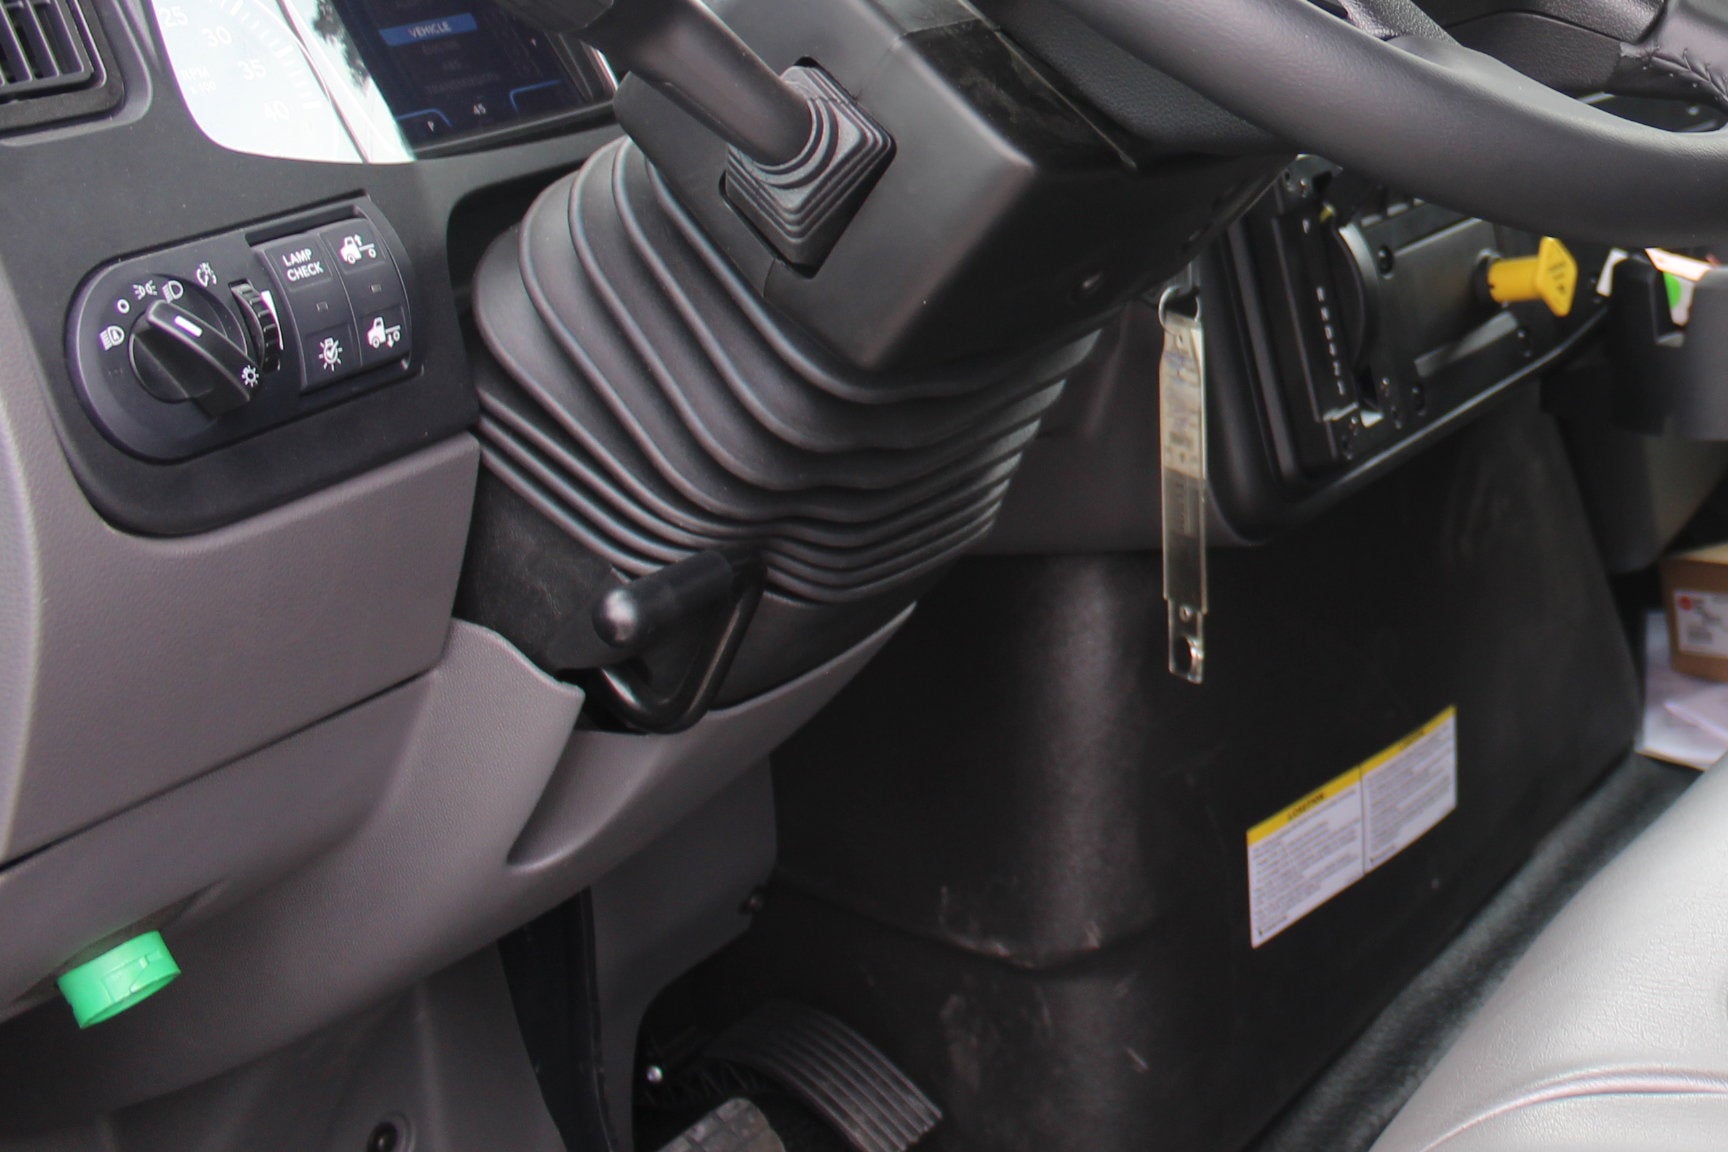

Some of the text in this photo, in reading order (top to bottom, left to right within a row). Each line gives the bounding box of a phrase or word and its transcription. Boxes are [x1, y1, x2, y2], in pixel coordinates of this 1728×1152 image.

[159, 6, 189, 28] 25
[202, 25, 233, 48] 30
[408, 21, 453, 39] VEHICLE
[237, 58, 267, 81] 35
[264, 100, 290, 122] 40
[282, 248, 313, 268] LAMP
[286, 260, 325, 282] CHECK
